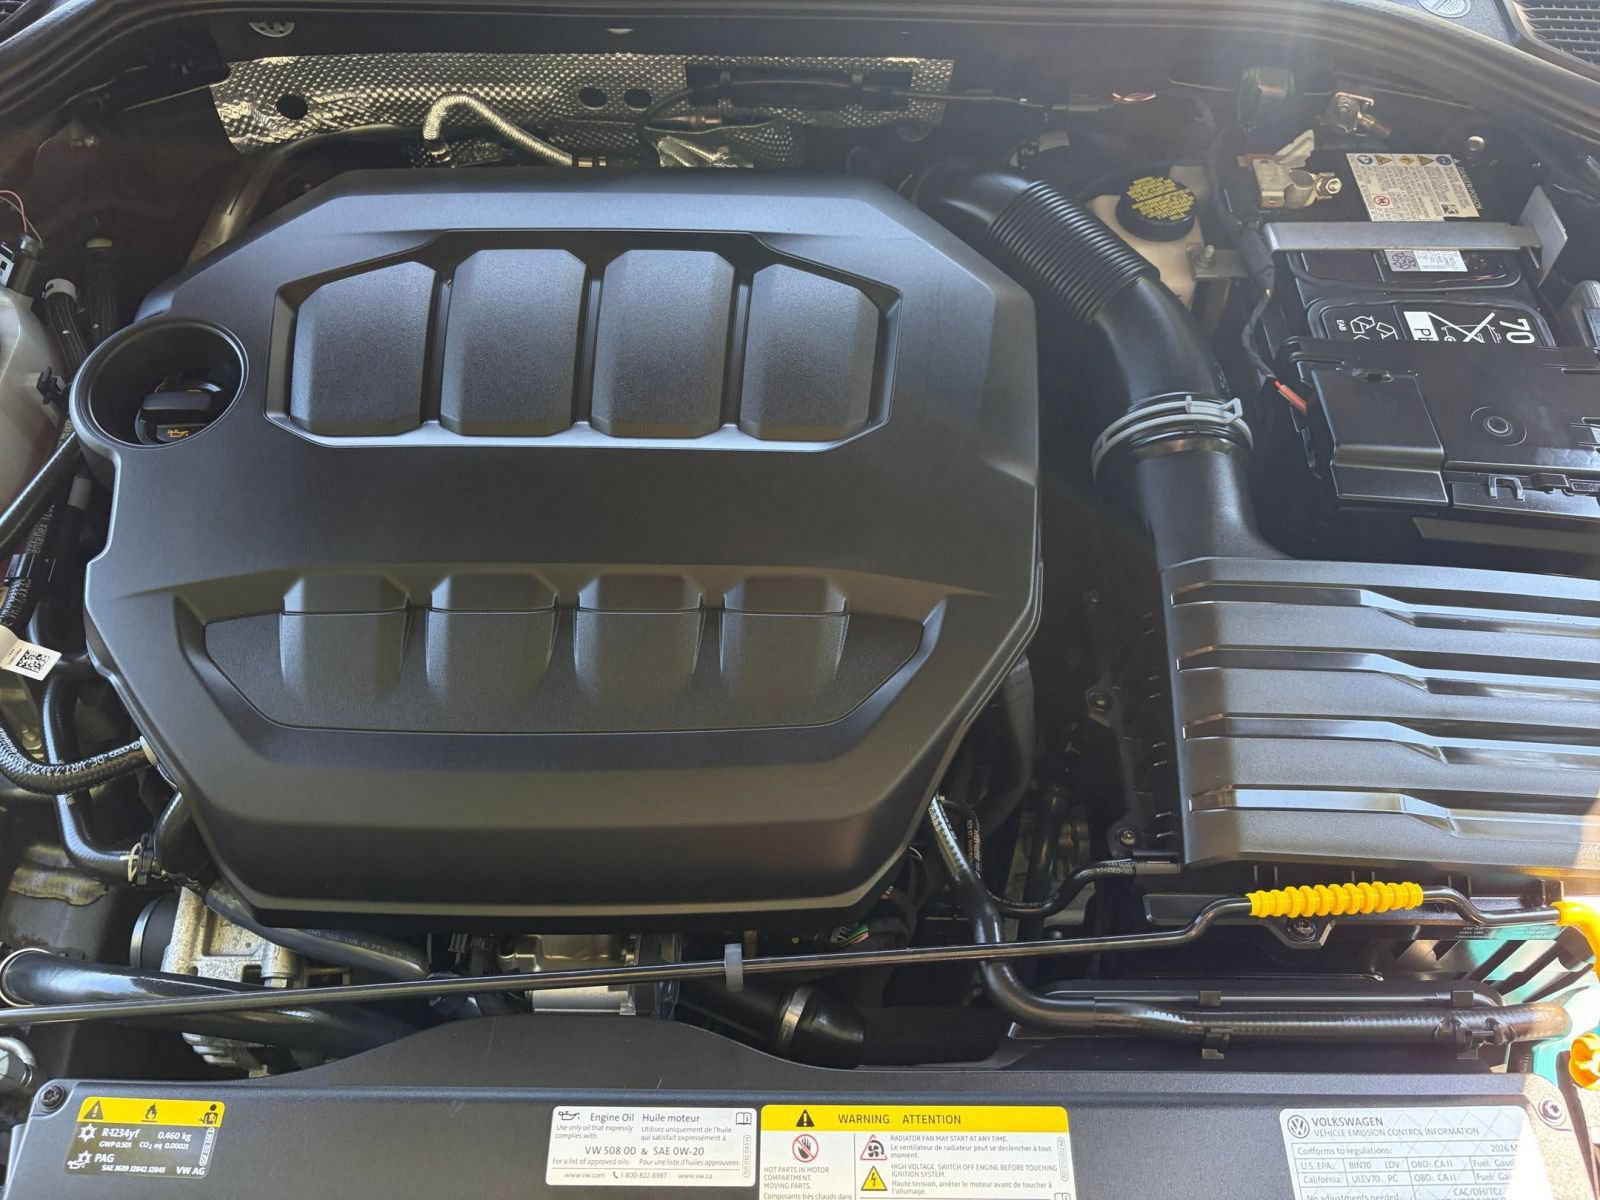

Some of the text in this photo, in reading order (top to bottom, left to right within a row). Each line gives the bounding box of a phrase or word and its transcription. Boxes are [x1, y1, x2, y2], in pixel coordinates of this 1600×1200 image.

[1500, 319, 1535, 343] 70
[590, 1113, 634, 1123] Engine Oil
[642, 1113, 700, 1122] Huile moteur
[838, 1114, 961, 1124] WARNING ATTENTION
[1311, 1117, 1384, 1127] VOLKSWAGEN
[568, 1124, 581, 1132] only
[605, 1125, 633, 1133] expressly
[1314, 1127, 1479, 1137] VEHICLE EMISSION CONTROL INFORMATION
[102, 1128, 140, 1140] R-1234yf
[182, 1131, 192, 1142] kg
[585, 1146, 602, 1155] VW
[604, 1146, 621, 1155] 508
[623, 1146, 637, 1155] 00
[653, 1146, 670, 1156] SAE
[673, 1147, 705, 1156] 0W-20
[1298, 1147, 1335, 1155] Conforms
[1336, 1147, 1345, 1155] to
[1491, 1144, 1509, 1153] 2026
[94, 1153, 115, 1162] PAG
[587, 1158, 616, 1166] approved
[1348, 1161, 1371, 1169] BIN70
[176, 1166, 191, 1174] VW
[192, 1167, 205, 1175] AG
